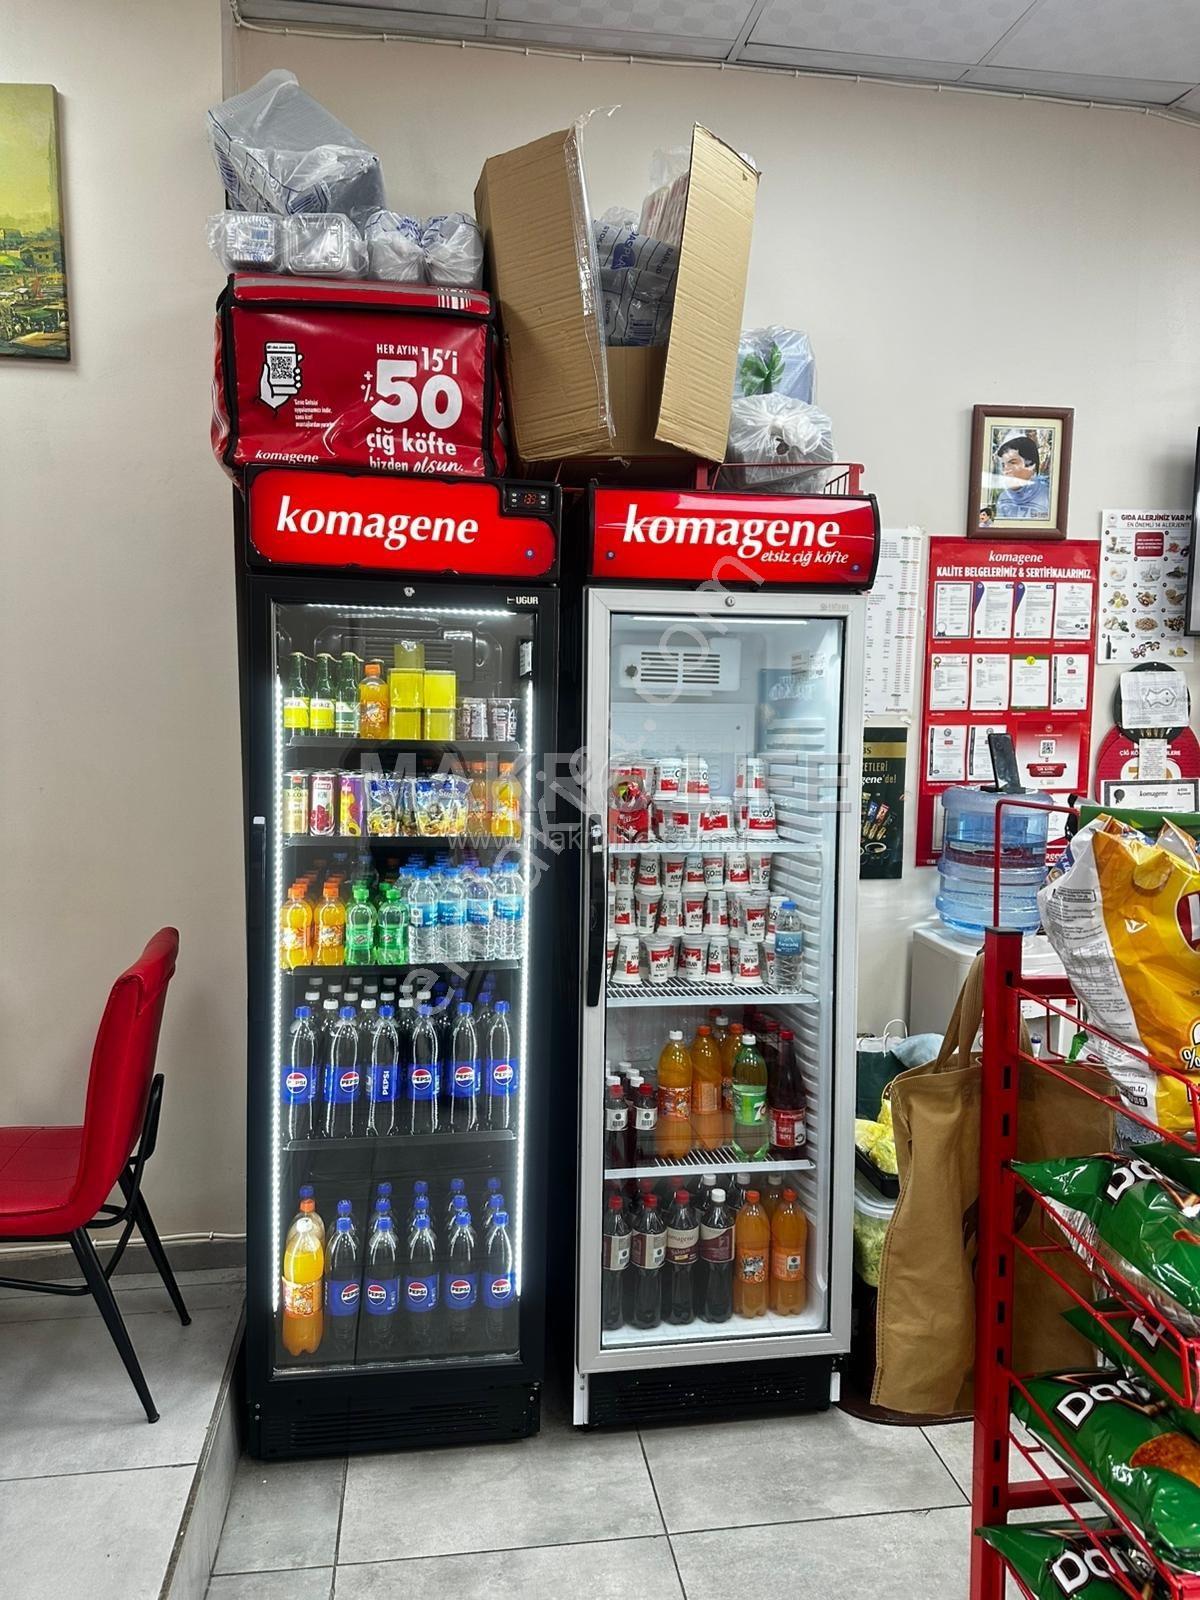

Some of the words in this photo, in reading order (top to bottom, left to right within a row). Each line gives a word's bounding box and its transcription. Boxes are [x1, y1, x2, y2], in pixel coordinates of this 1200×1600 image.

[376, 343, 394, 354] HER
[396, 345, 419, 356] AYIN
[370, 358, 463, 430] 50
[366, 427, 395, 456] çiğ
[402, 428, 457, 456] köfte
[255, 450, 319, 464] komagene
[369, 455, 408, 471] bizden
[276, 495, 479, 551] komagene
[622, 503, 840, 559] komagene
[761, 550, 790, 563] etsiz
[792, 549, 815, 567] çiğ
[815, 551, 849, 565] köfte
[988, 550, 1043, 565] komagene
[936, 565, 963, 577] KALİTE
[964, 565, 1017, 578] BELGELERİMİZ
[1018, 567, 1025, 578] &
[1026, 566, 1091, 579] SERTİFİKALARIMIZ
[863, 760, 888, 772] ETLERİ
[382, 1070, 390, 1096] PEPSI
